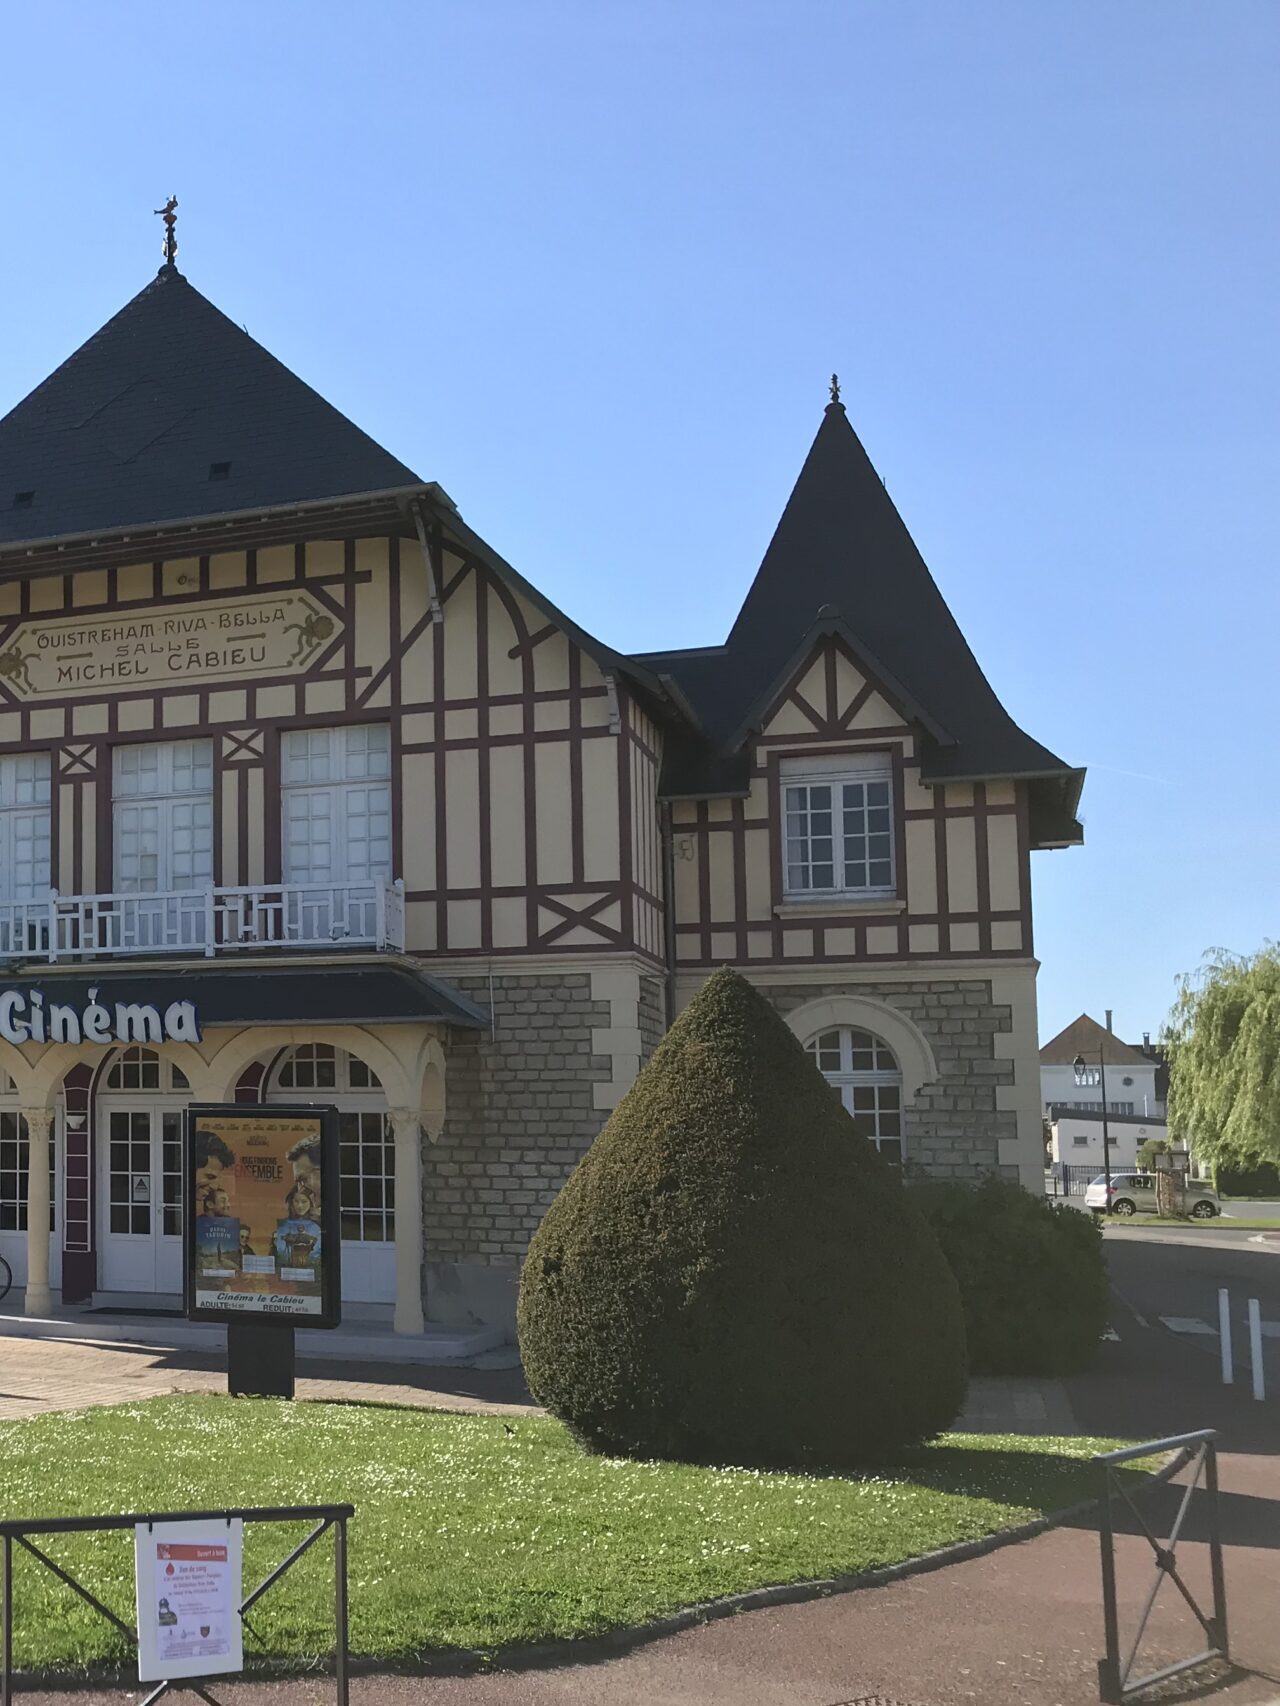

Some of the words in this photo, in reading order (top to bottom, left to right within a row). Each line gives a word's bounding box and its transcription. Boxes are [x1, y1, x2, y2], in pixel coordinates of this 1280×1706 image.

[115, 637, 200, 658] SALLE
[56, 659, 149, 683] MICHEL
[167, 645, 267, 671] CABIEU
[216, 1292, 254, 1302] Cinéma
[257, 1293, 266, 1303] le
[270, 1294, 304, 1305] Cabieu
